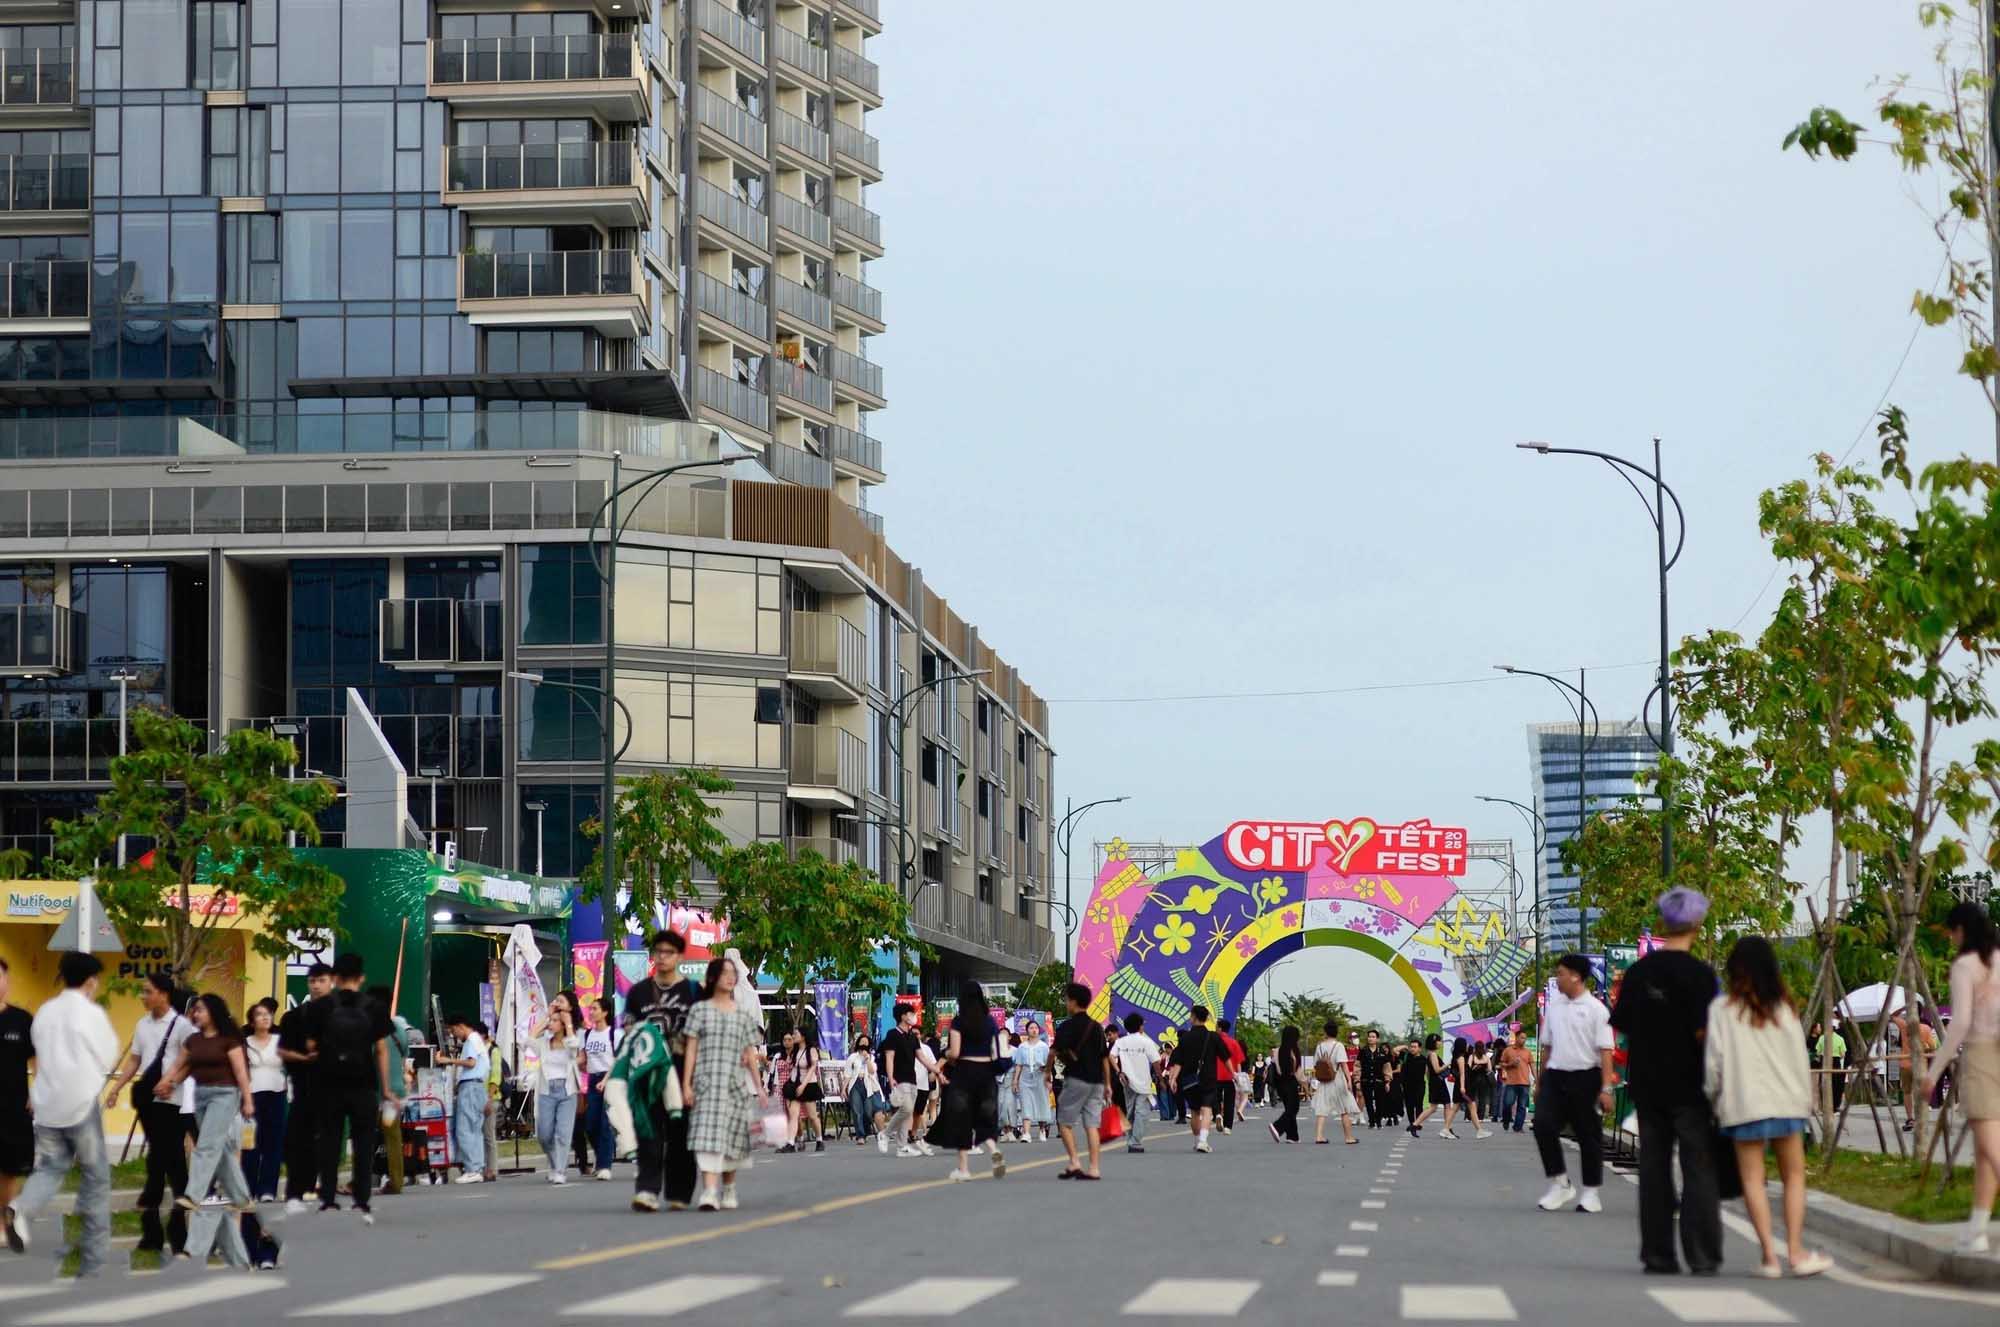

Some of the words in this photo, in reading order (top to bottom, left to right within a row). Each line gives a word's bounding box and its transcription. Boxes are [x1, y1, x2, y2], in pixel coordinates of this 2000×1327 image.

[1378, 821, 1443, 848] TẾT
[1445, 831, 1462, 840] 20
[1445, 841, 1462, 849] 25
[1376, 852, 1463, 871] FEST
[9, 893, 72, 908] Nutifood
